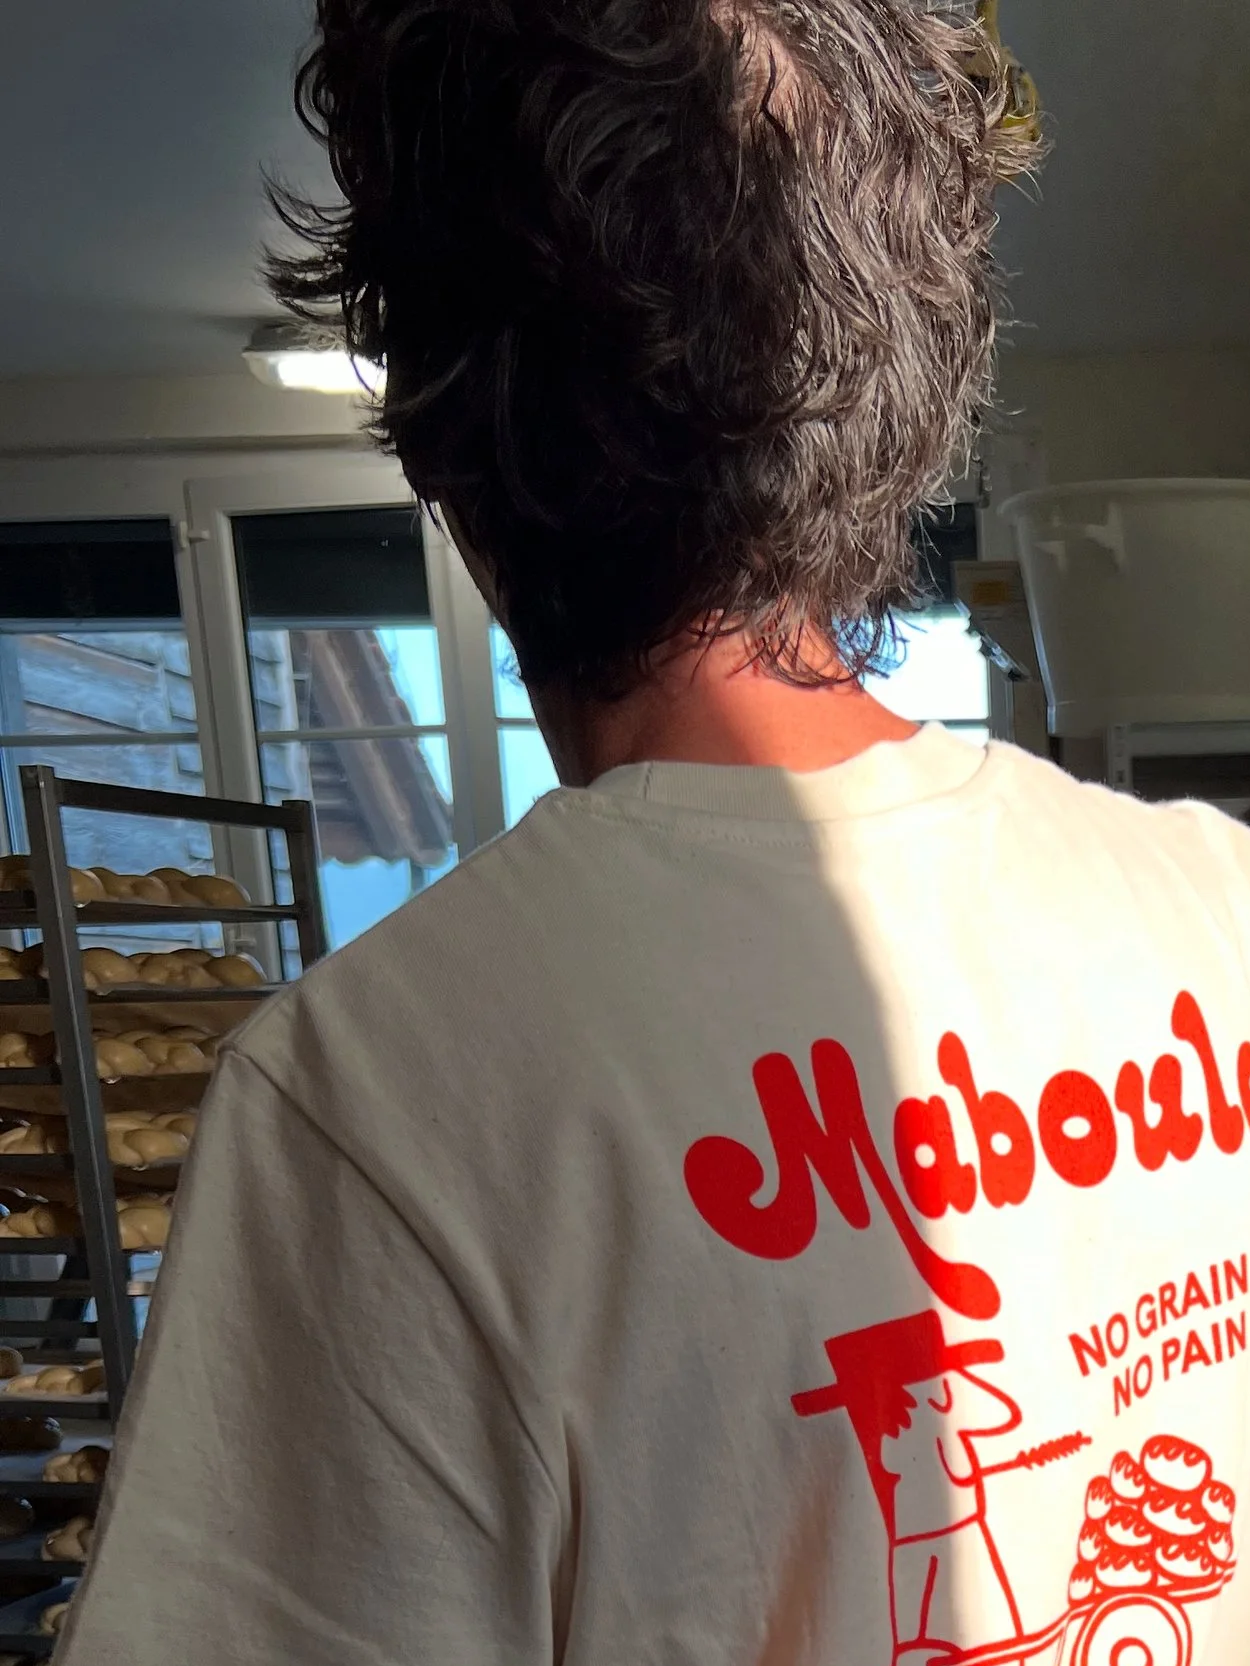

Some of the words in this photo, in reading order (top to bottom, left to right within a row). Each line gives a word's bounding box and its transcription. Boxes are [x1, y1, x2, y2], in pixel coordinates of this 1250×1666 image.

[1067, 1312, 1129, 1377] NO
[1135, 1253, 1248, 1339] GRAIN
[1112, 1354, 1153, 1418] NO
[1161, 1310, 1247, 1382] PAIN
